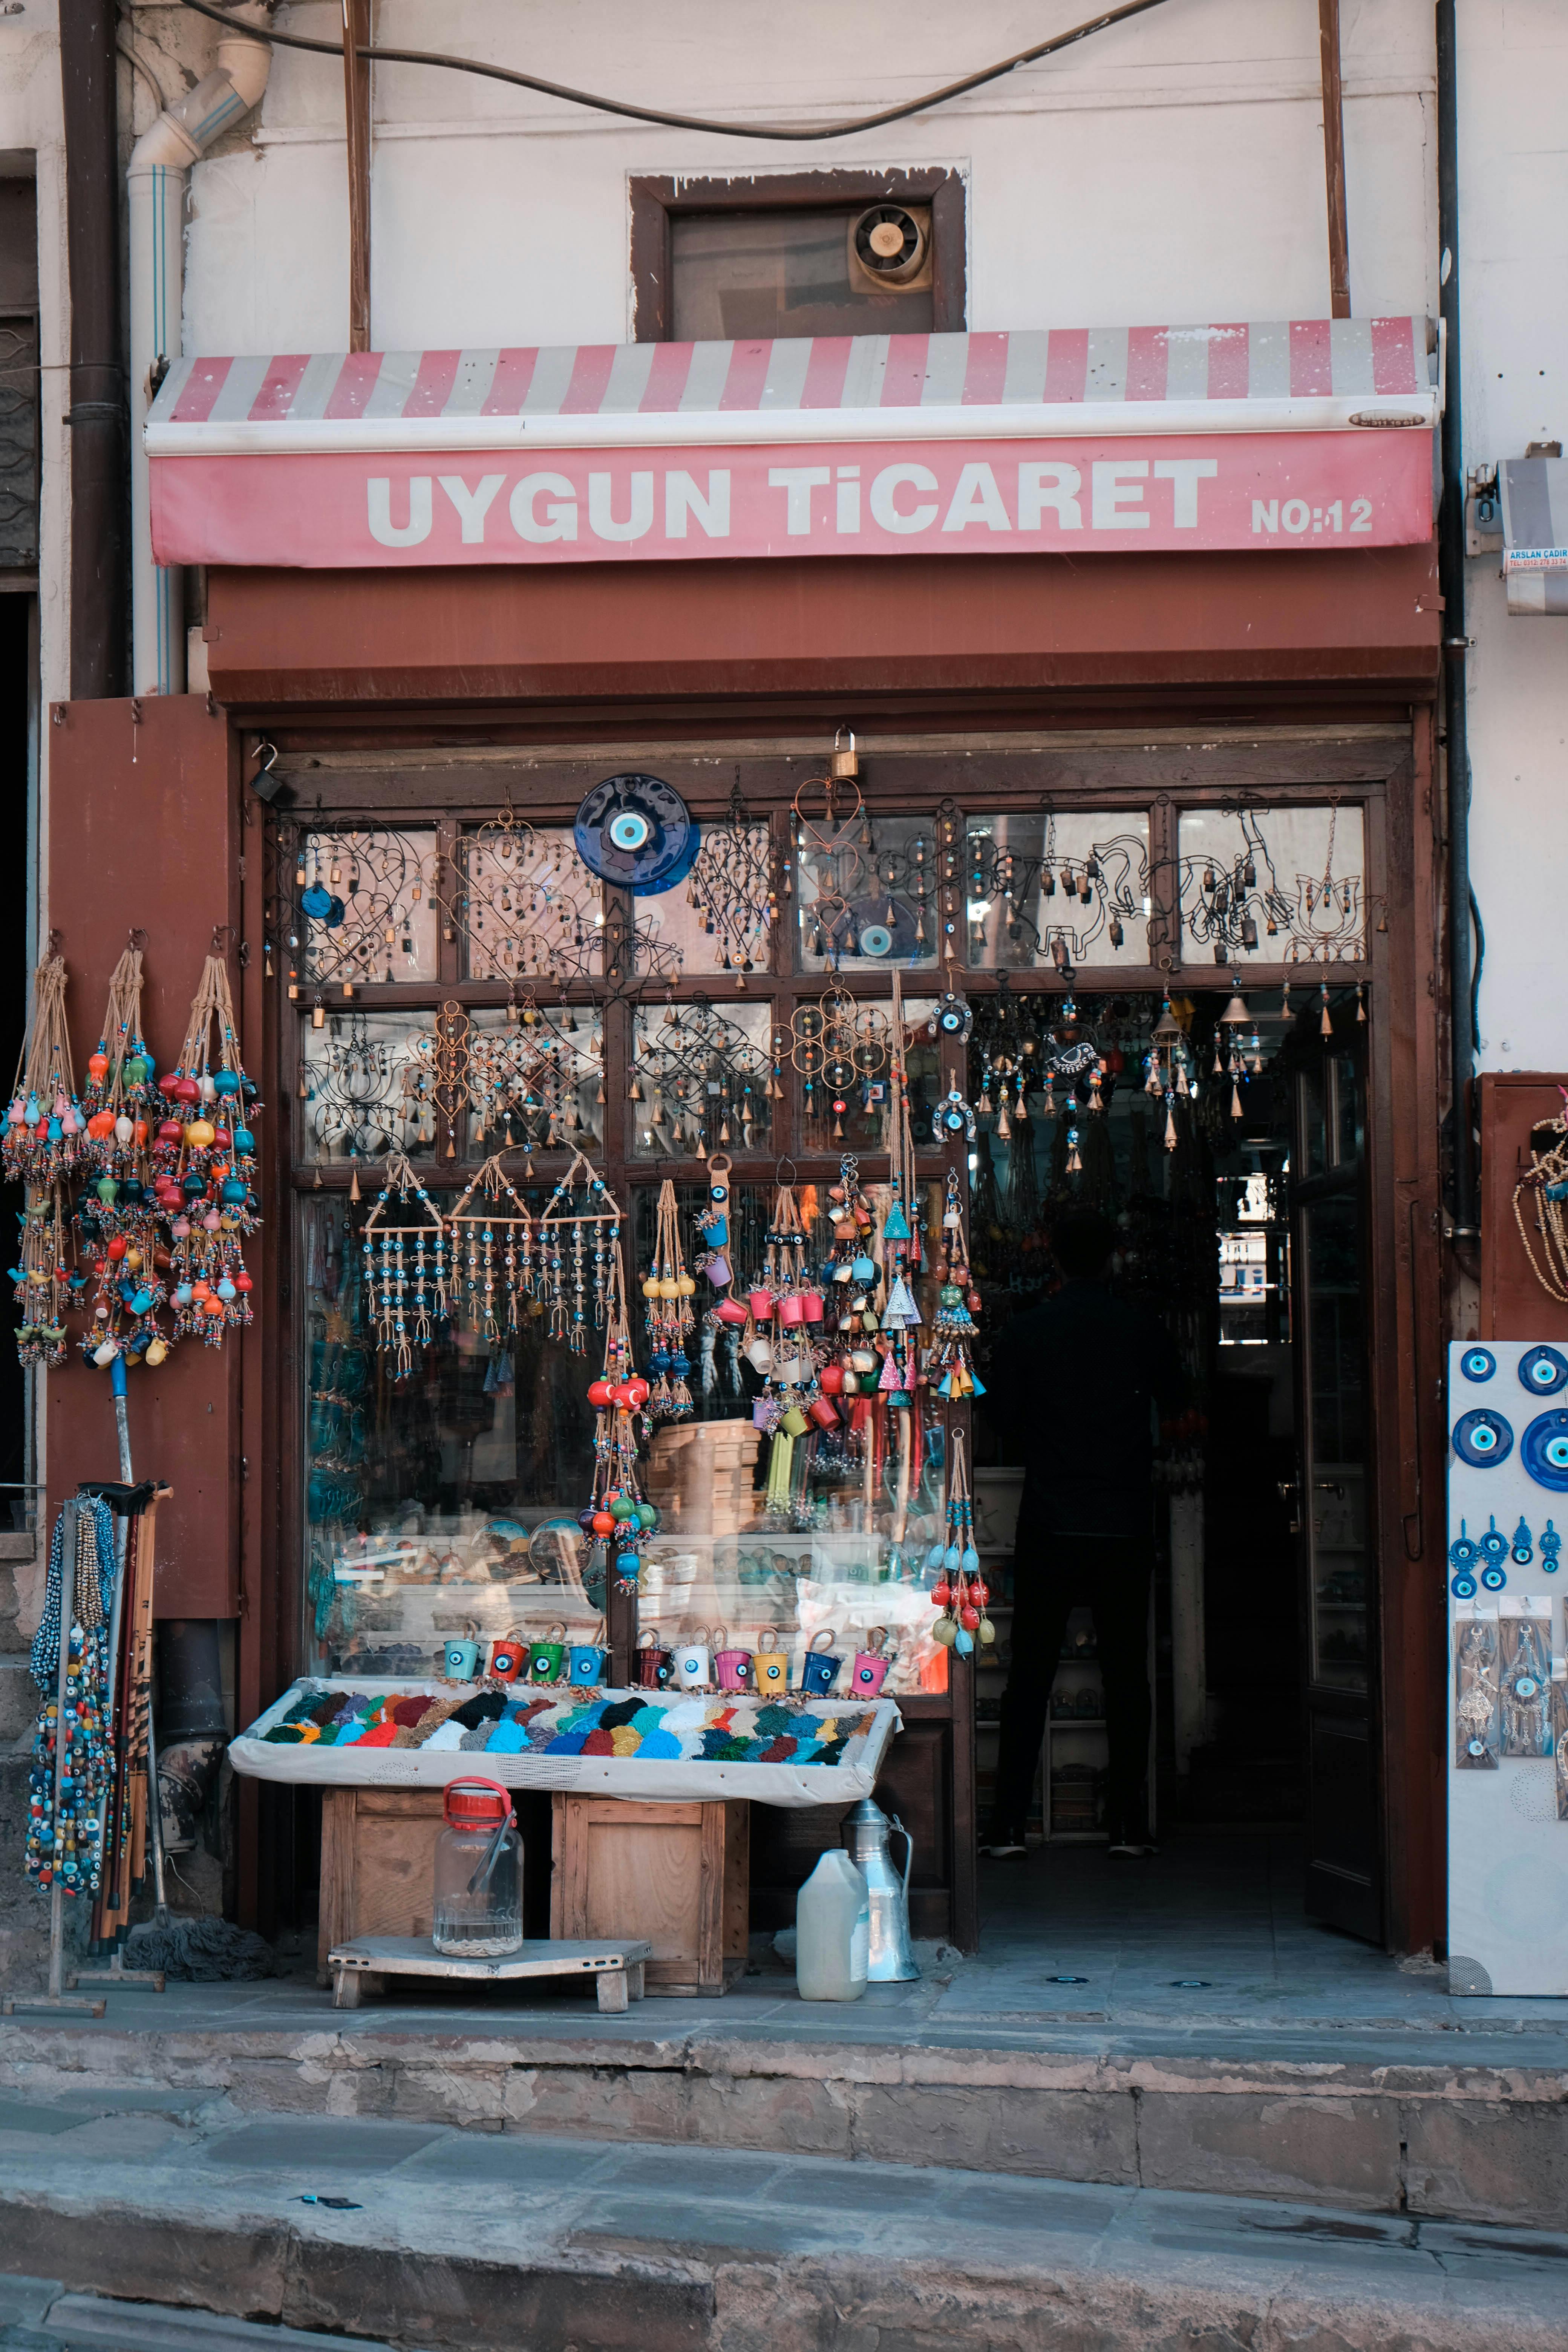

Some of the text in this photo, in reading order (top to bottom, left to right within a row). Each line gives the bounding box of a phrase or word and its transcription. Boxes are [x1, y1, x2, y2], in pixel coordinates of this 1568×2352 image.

[368, 470, 730, 548] UYGUN
[1252, 499, 1372, 533] NO:12
[1510, 549, 1568, 559] ARSLAN ÇADIR
